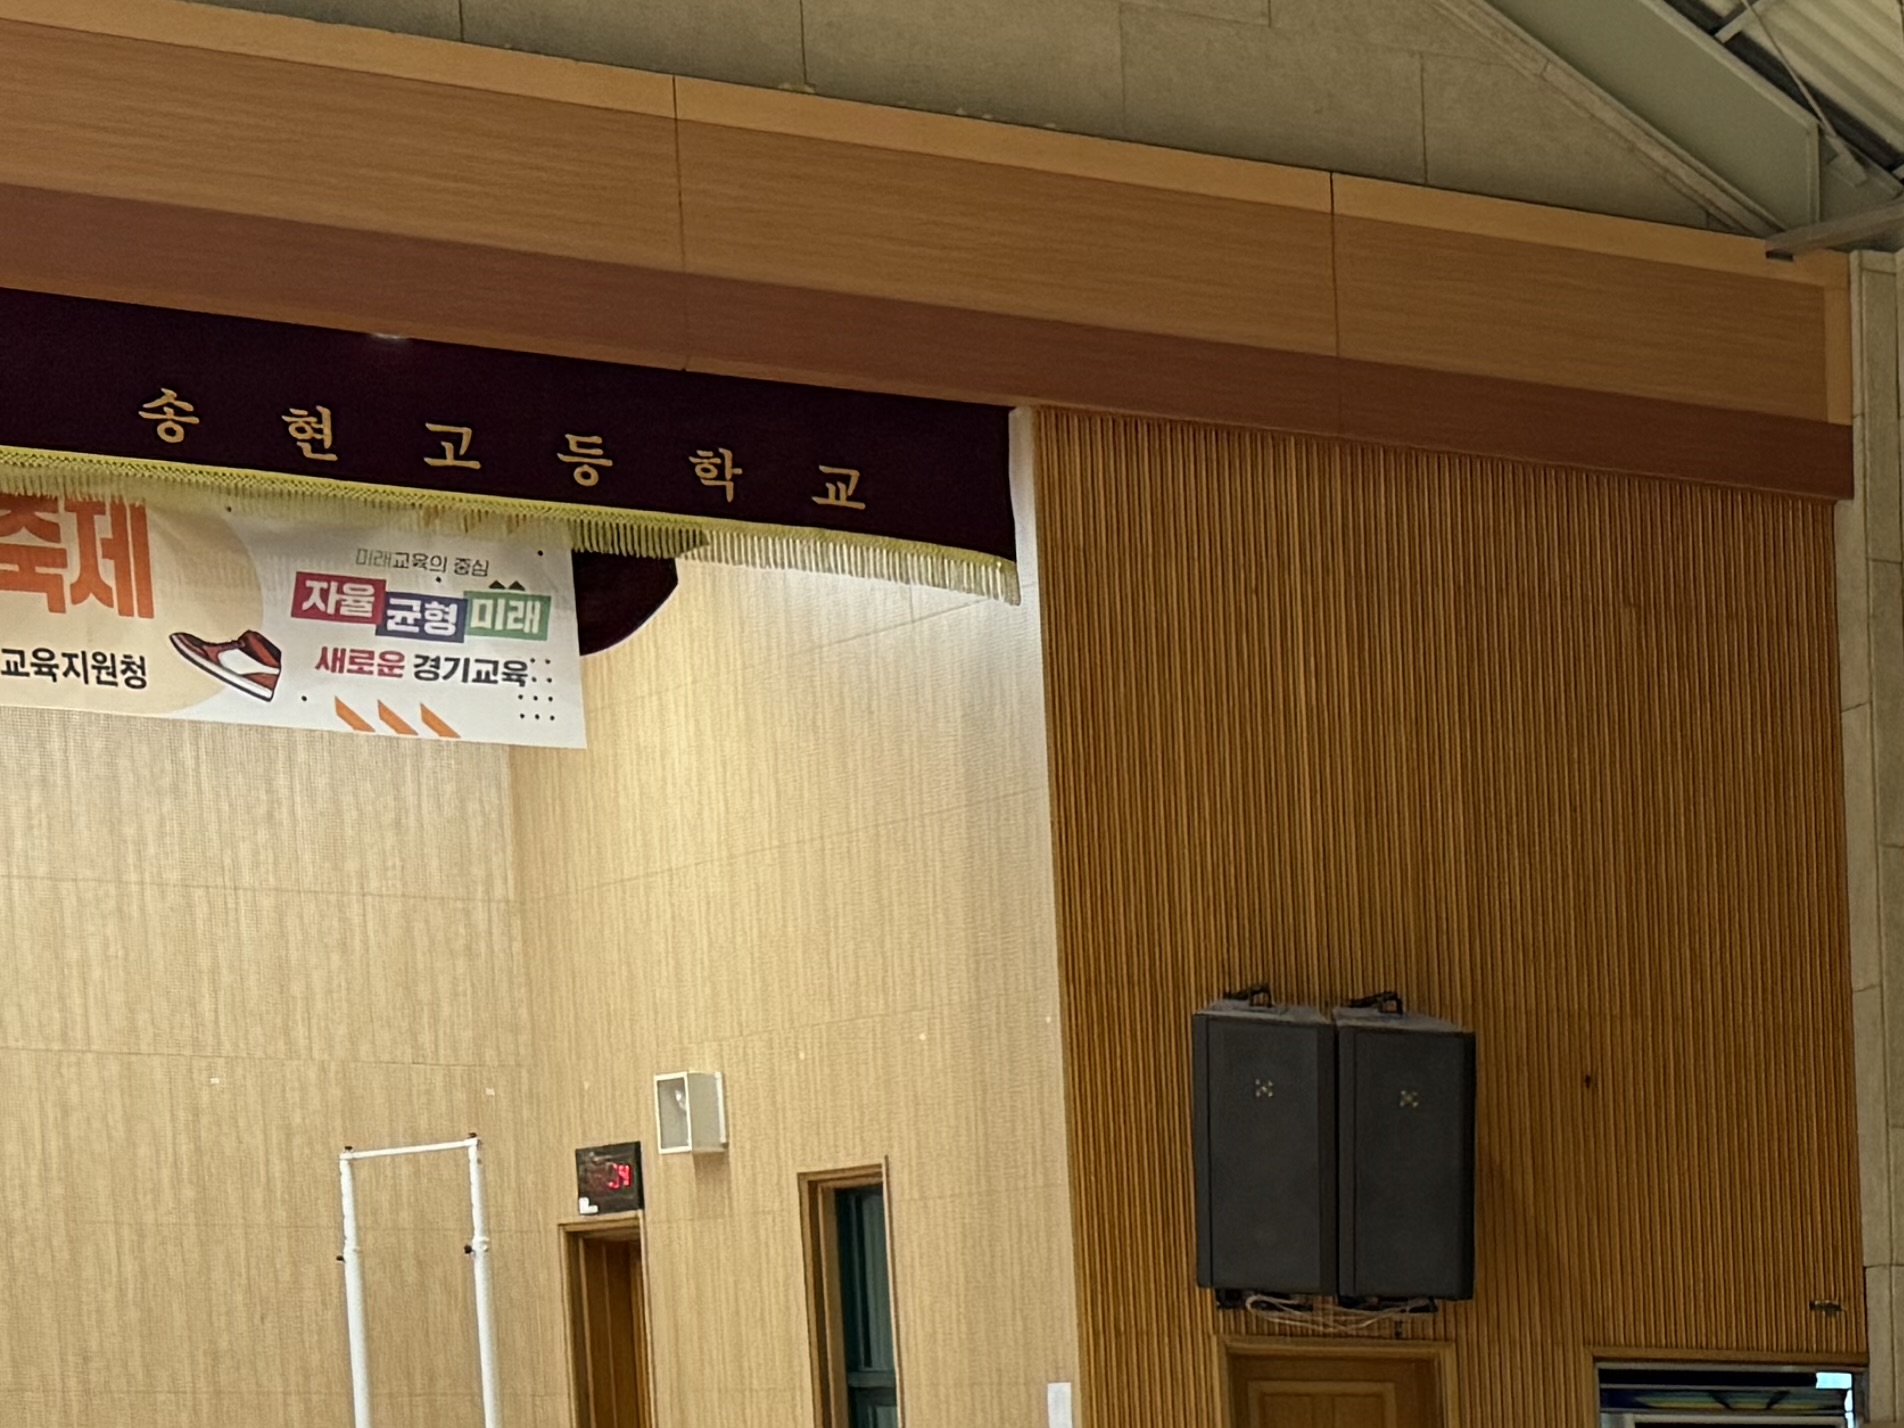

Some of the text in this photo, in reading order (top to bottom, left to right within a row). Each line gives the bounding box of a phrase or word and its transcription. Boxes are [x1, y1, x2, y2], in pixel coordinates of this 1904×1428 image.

[138, 387, 866, 510] 송현고등학교
[453, 557, 490, 577] 중심
[301, 579, 542, 637] 자율 균형 미래
[0, 646, 149, 691] 교육지원청
[314, 645, 529, 688] 새로운 경기교육
